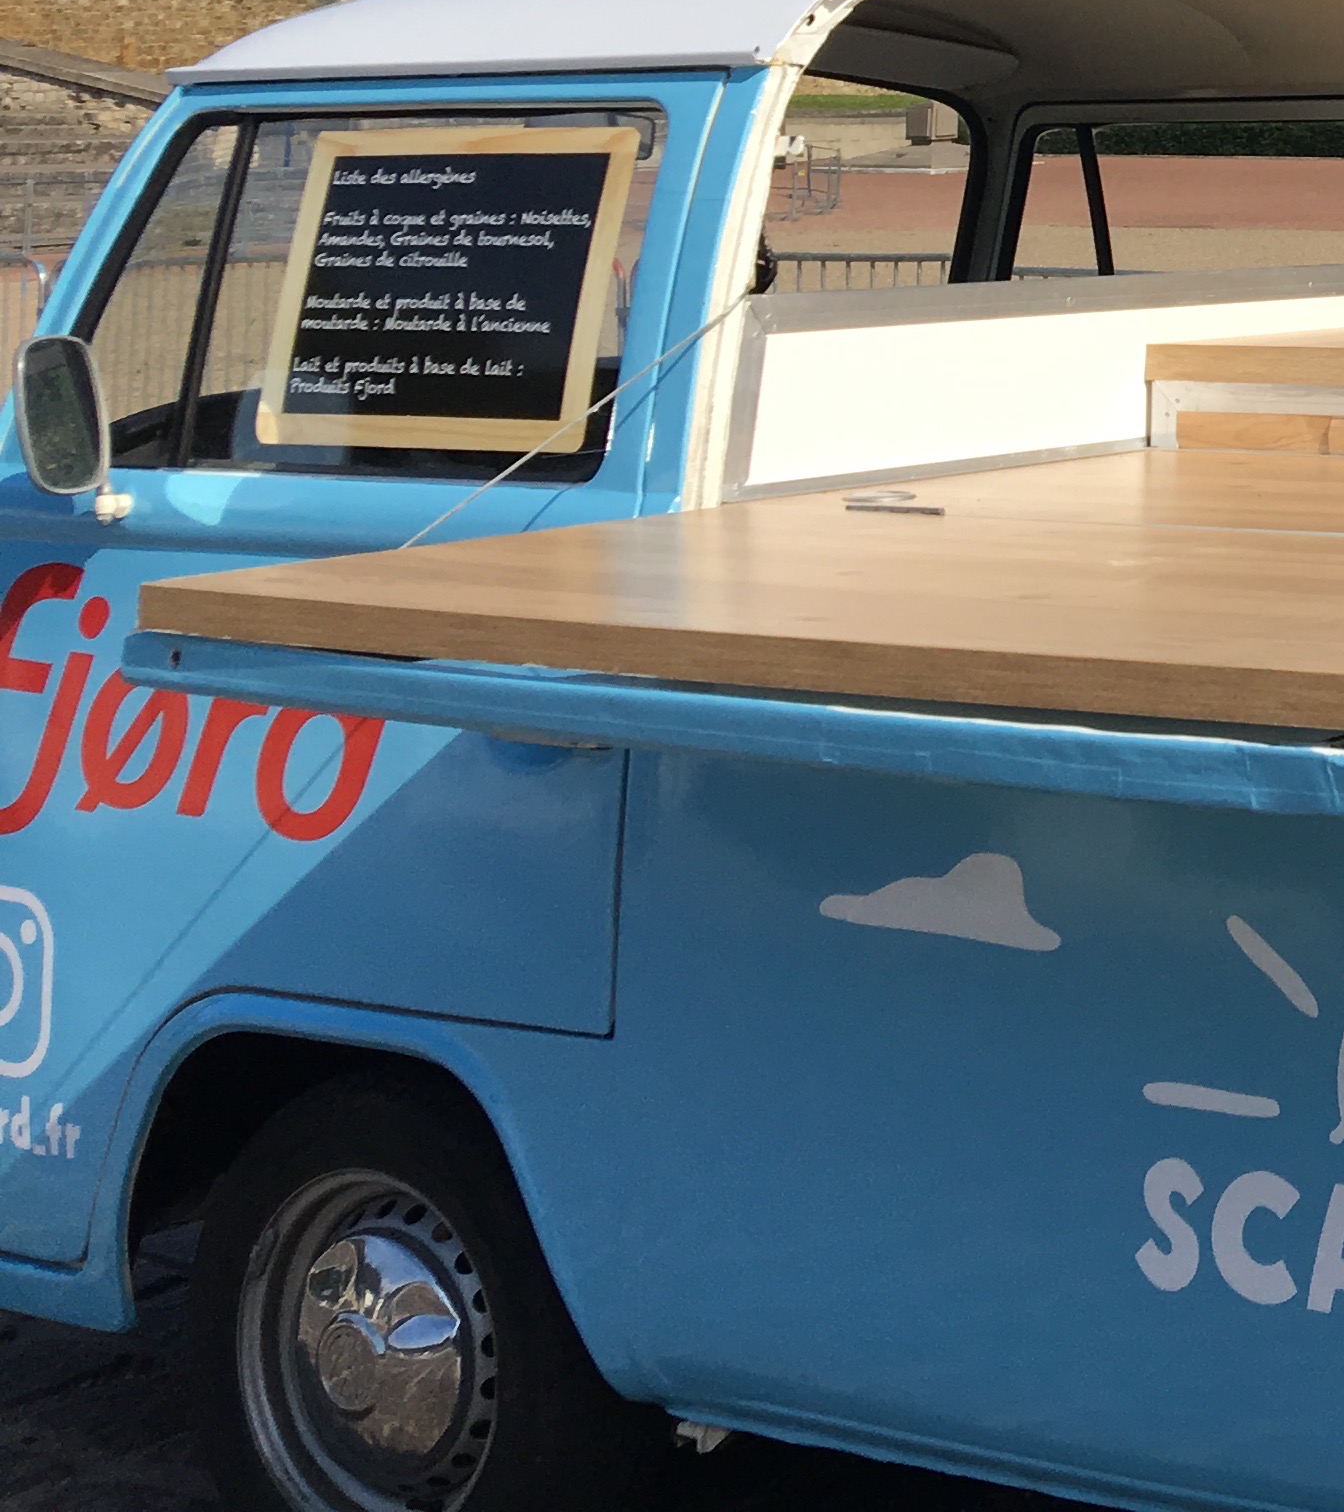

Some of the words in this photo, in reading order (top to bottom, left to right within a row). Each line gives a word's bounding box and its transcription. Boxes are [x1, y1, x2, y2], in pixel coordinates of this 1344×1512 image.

[332, 170, 367, 186] Liste
[370, 169, 397, 185] des
[400, 166, 476, 189] allergènes
[323, 211, 367, 226] Fruits
[369, 210, 379, 225] à
[383, 213, 426, 229] coque
[430, 211, 446, 225] et
[449, 213, 505, 230] graines
[520, 210, 592, 227] Noisettes,
[318, 232, 385, 250] Amandes,
[390, 232, 449, 247] Graines
[453, 231, 473, 246] de
[477, 232, 554, 250] tournesol,
[314, 253, 372, 268] Graines
[375, 253, 395, 268] de
[398, 252, 468, 269] citrouille
[305, 294, 371, 310] Moutarde
[375, 293, 390, 310] et
[394, 294, 449, 315] produit
[454, 293, 465, 310] à
[468, 294, 501, 310] base
[505, 294, 526, 311] de
[301, 315, 369, 331] moutarde
[382, 316, 451, 332] Moutarde
[456, 316, 467, 332] à
[470, 317, 550, 334] l'ancienne
[292, 356, 320, 372] Lait
[325, 357, 339, 373] et
[343, 359, 405, 381] produits
[409, 357, 419, 374] à
[422, 358, 457, 375] base
[459, 359, 481, 375] de
[484, 359, 514, 377] lait
[290, 378, 350, 394] Produits
[354, 379, 395, 400] Fjord
